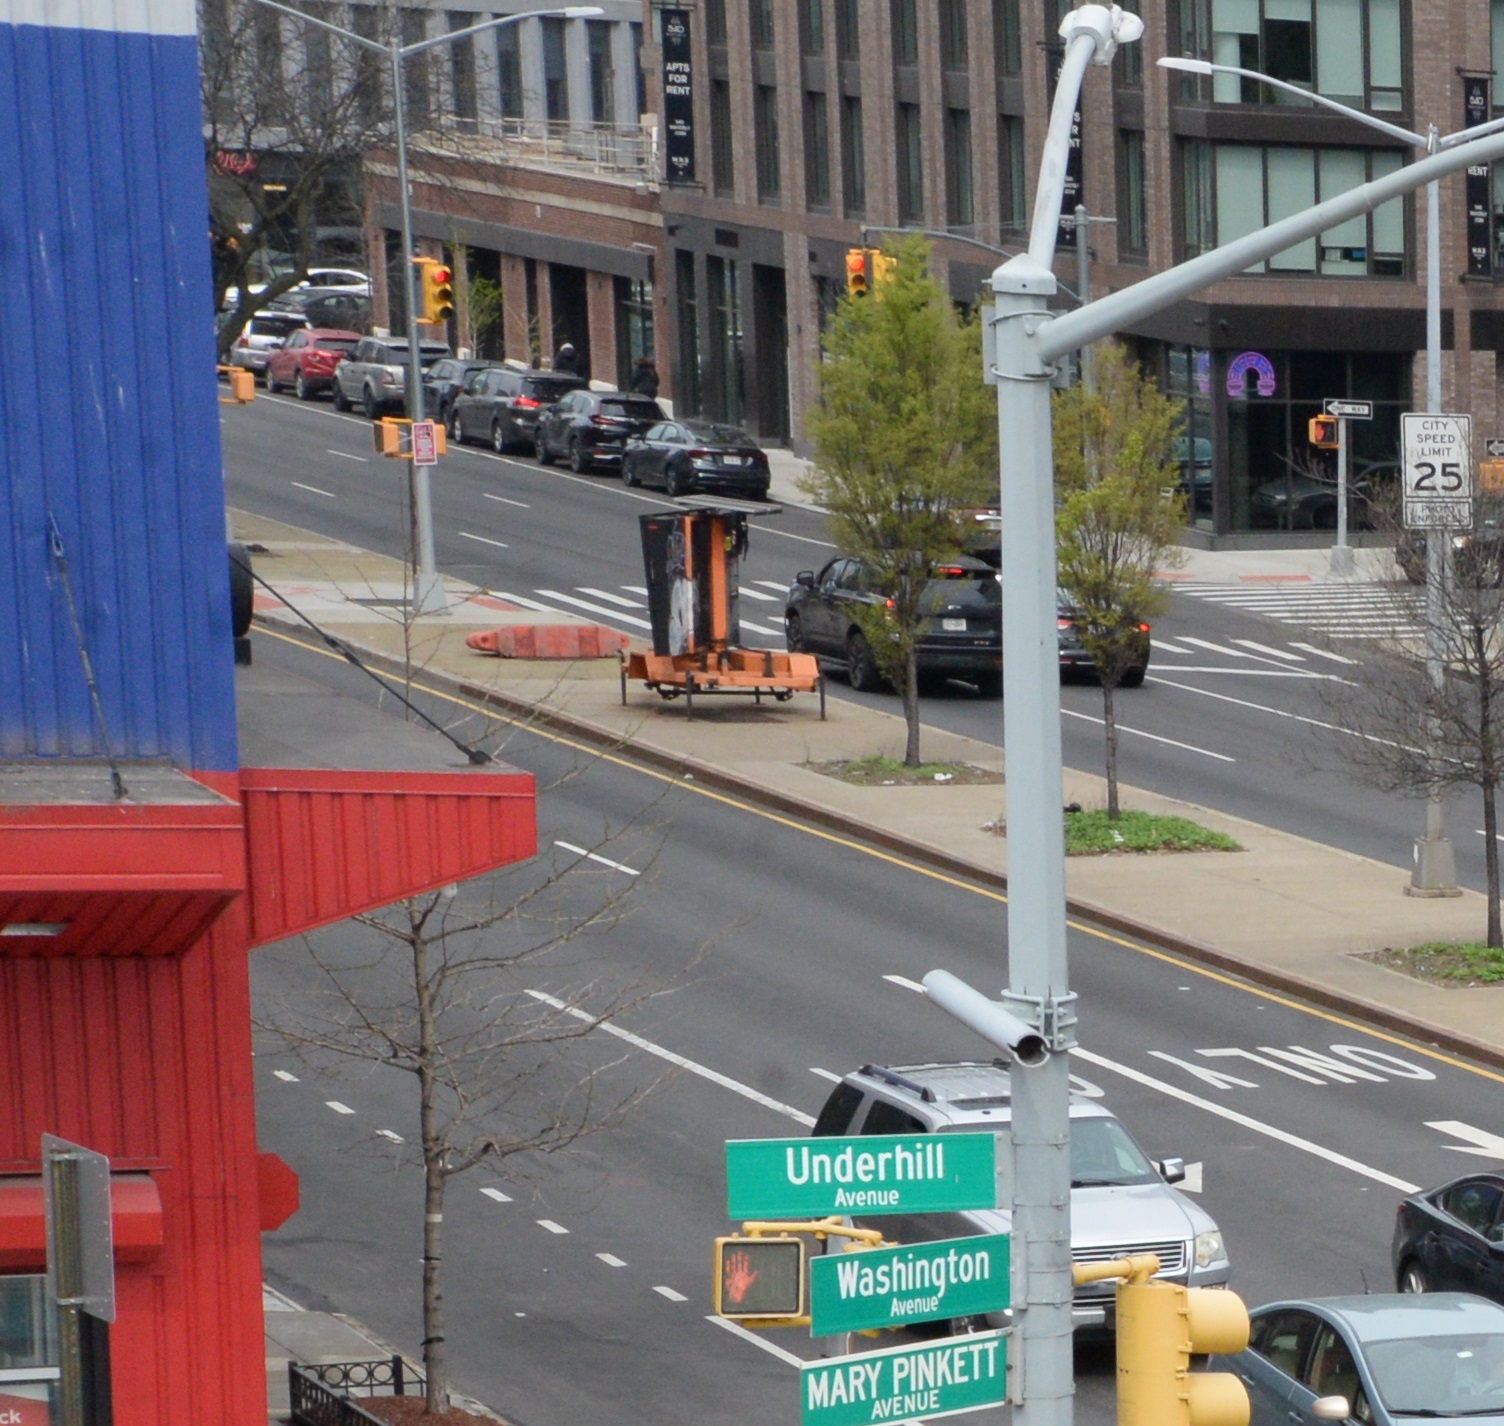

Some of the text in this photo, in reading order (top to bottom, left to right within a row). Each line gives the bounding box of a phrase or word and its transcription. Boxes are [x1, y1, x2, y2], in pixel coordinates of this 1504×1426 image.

[666, 63, 690, 72] APTS
[668, 75, 687, 83] FOR
[666, 86, 690, 96] RENT
[1352, 406, 1366, 414] WAY
[1422, 420, 1449, 430] CITY
[1416, 434, 1455, 444] SPEED
[1421, 448, 1452, 456] LIMIT
[1414, 462, 1463, 492] 25
[1147, 1044, 1436, 1090] ONLY
[786, 1143, 944, 1185] Underhill
[834, 1188, 899, 1208] Avenue
[837, 1249, 990, 1300] Washington
[890, 1296, 940, 1318] Avenue
[808, 1342, 1000, 1410] MARY PINKETT
[871, 1390, 940, 1420] AVENUE
